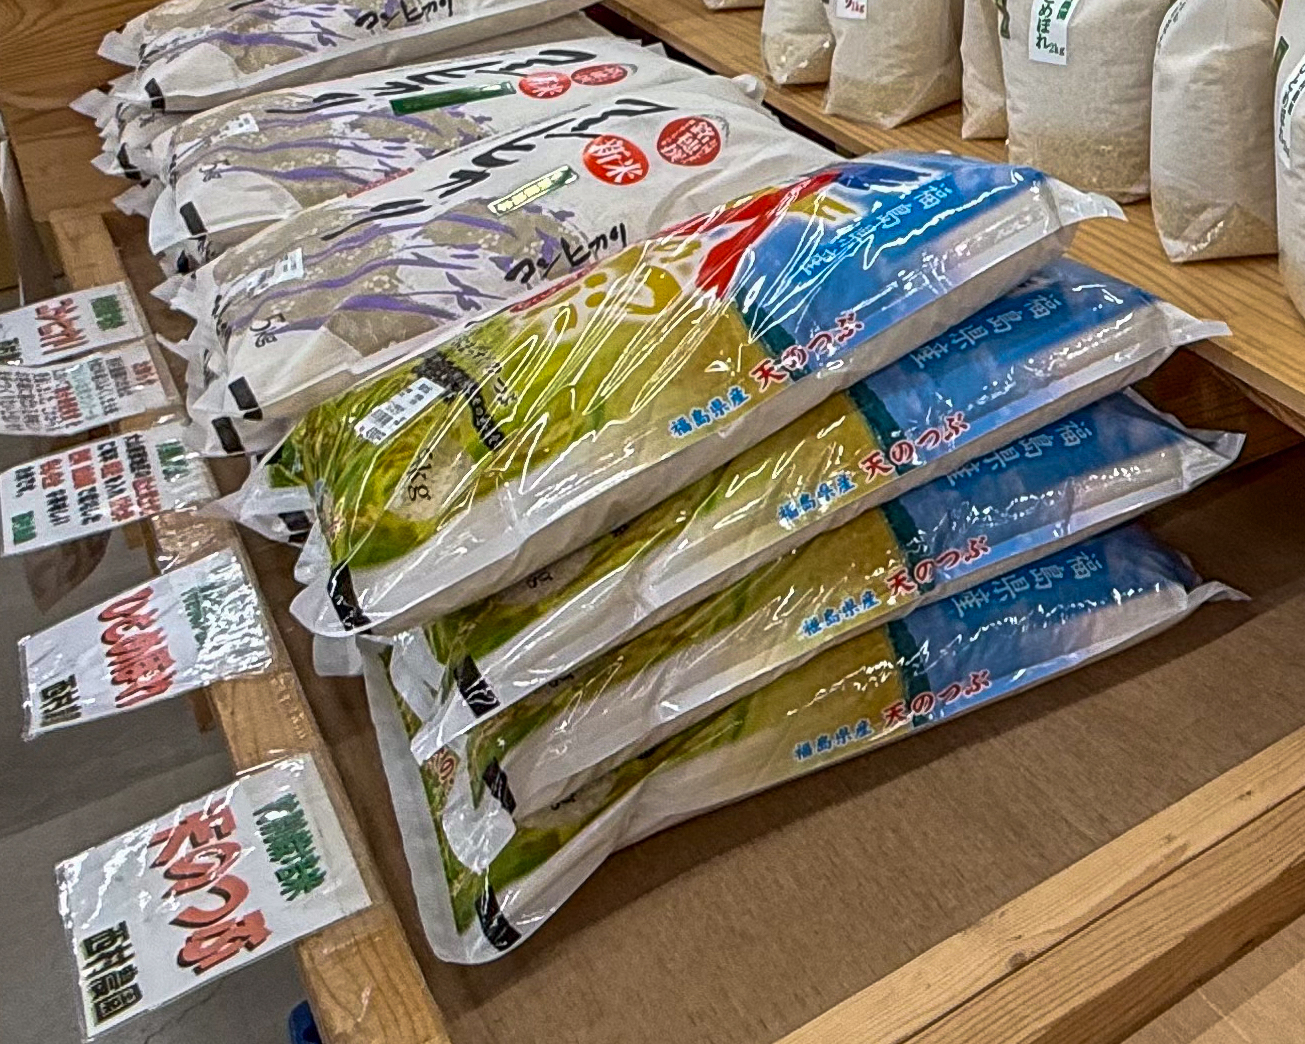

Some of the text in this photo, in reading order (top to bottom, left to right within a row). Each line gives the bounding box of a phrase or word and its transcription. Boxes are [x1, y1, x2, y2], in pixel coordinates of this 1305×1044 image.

[590, 138, 647, 183] 新米
[749, 311, 866, 393] 天のつぶ
[669, 385, 752, 440] 福島県産
[858, 411, 971, 478] 天のつぶ
[884, 535, 991, 598] 天のつぶ
[882, 669, 992, 728] 天のつぶ
